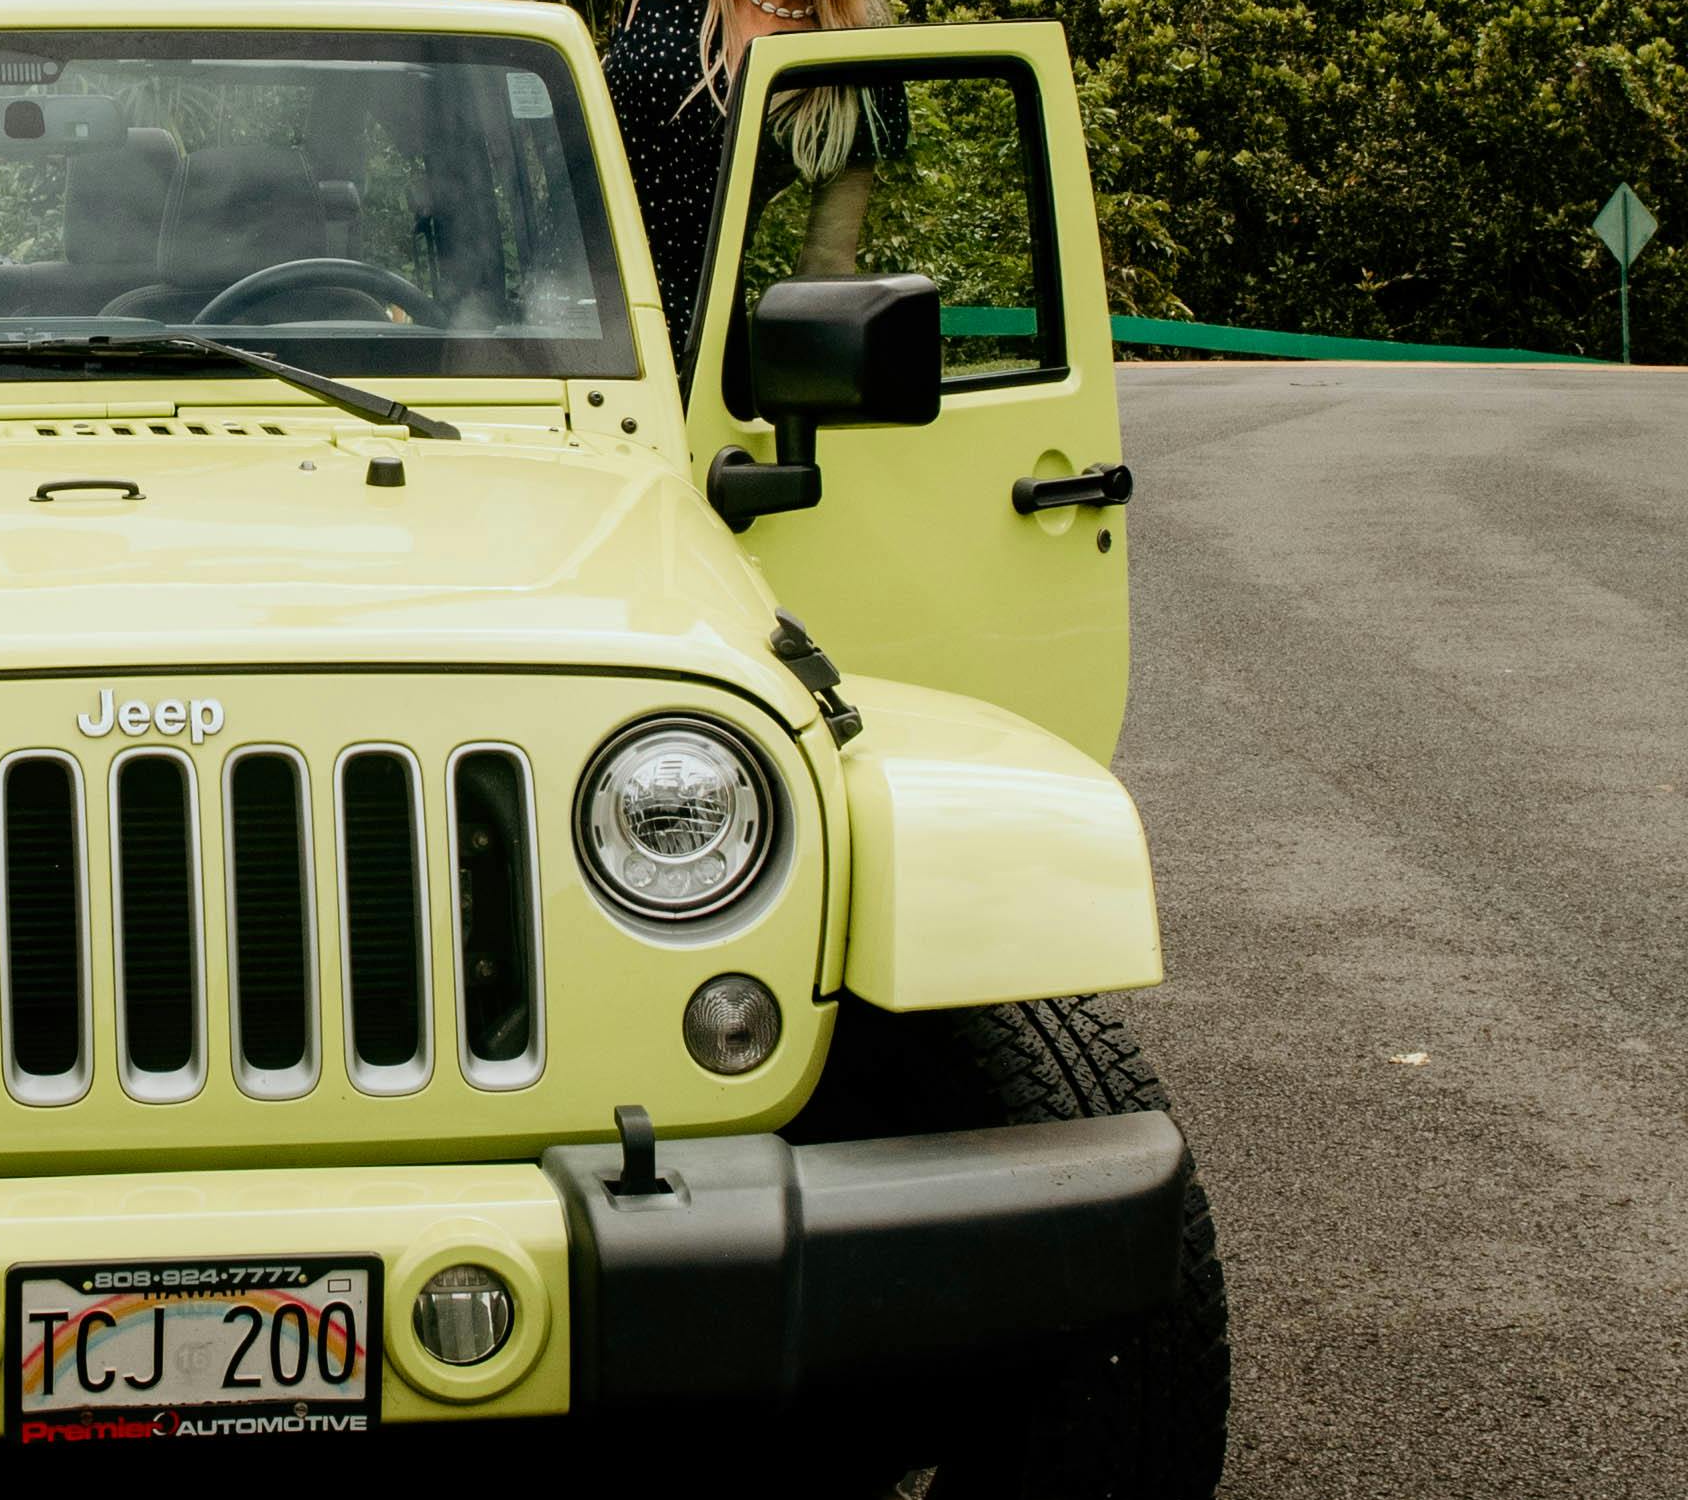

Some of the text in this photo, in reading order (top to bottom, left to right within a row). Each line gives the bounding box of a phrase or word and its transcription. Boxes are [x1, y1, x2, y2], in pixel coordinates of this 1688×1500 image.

[77, 688, 224, 744] Jeep
[29, 1302, 356, 1395] TCJ 200
[22, 1415, 368, 1444] Premier AUTOMOTIVE
